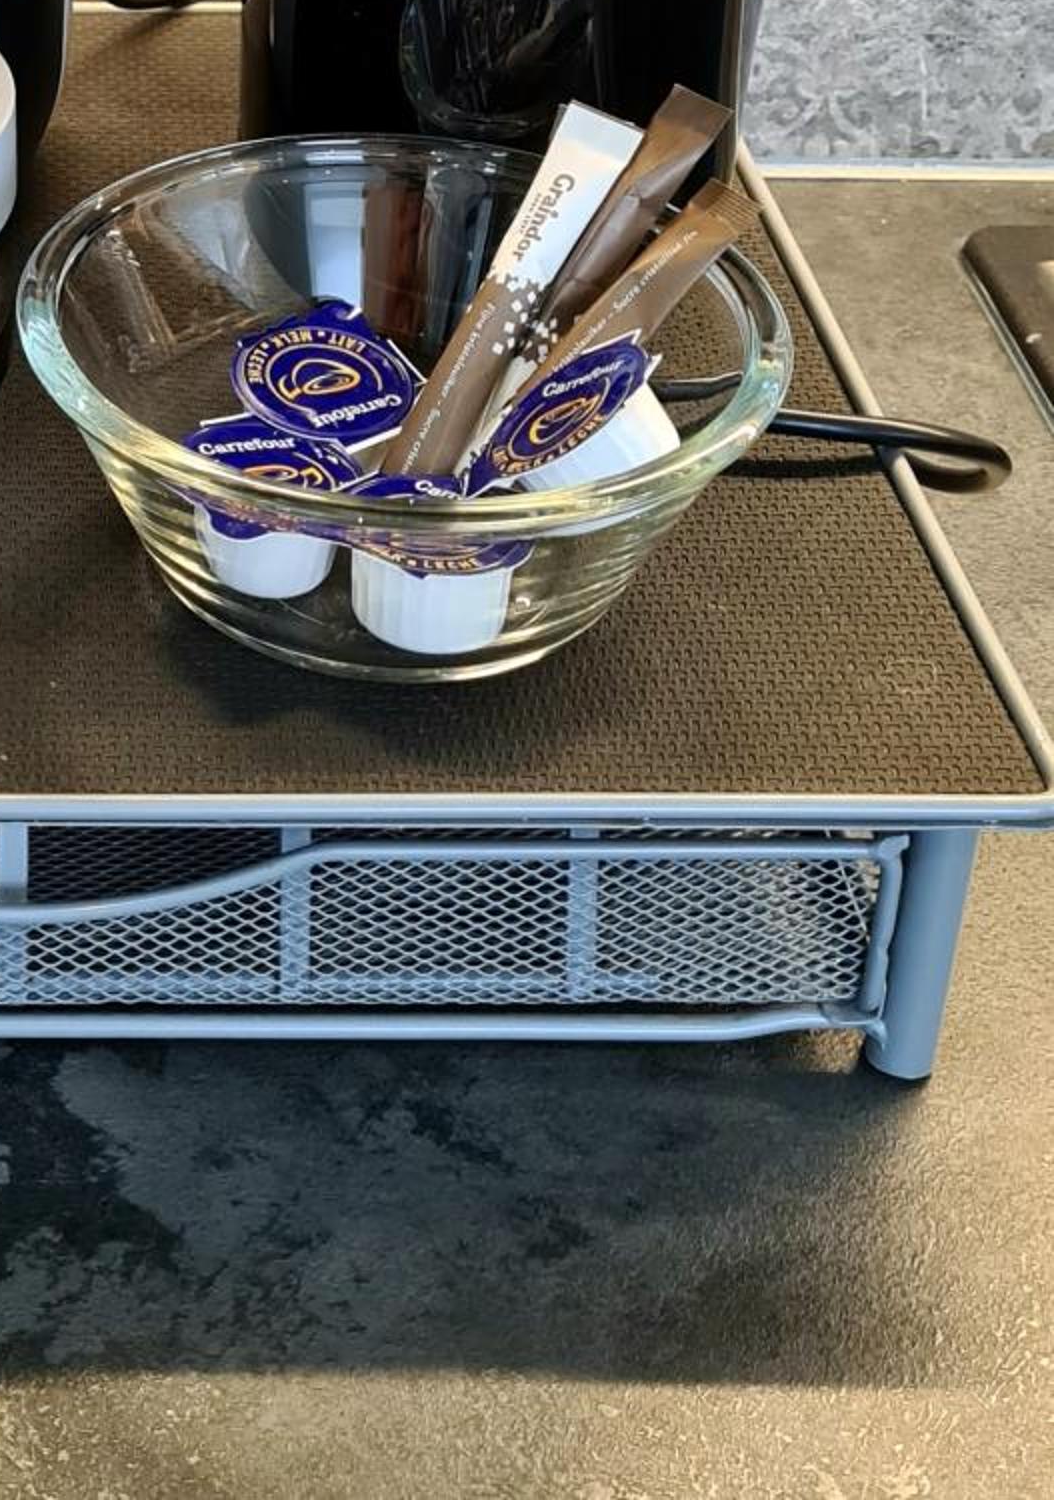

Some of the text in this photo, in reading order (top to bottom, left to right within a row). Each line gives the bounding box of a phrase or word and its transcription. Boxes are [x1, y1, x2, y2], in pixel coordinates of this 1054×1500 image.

[512, 173, 576, 262] Graindor
[248, 329, 368, 385] LAIT MELK LECHE
[541, 359, 626, 397] Carrefour
[307, 393, 403, 428] Carrefour
[198, 436, 297, 456] Carrefour
